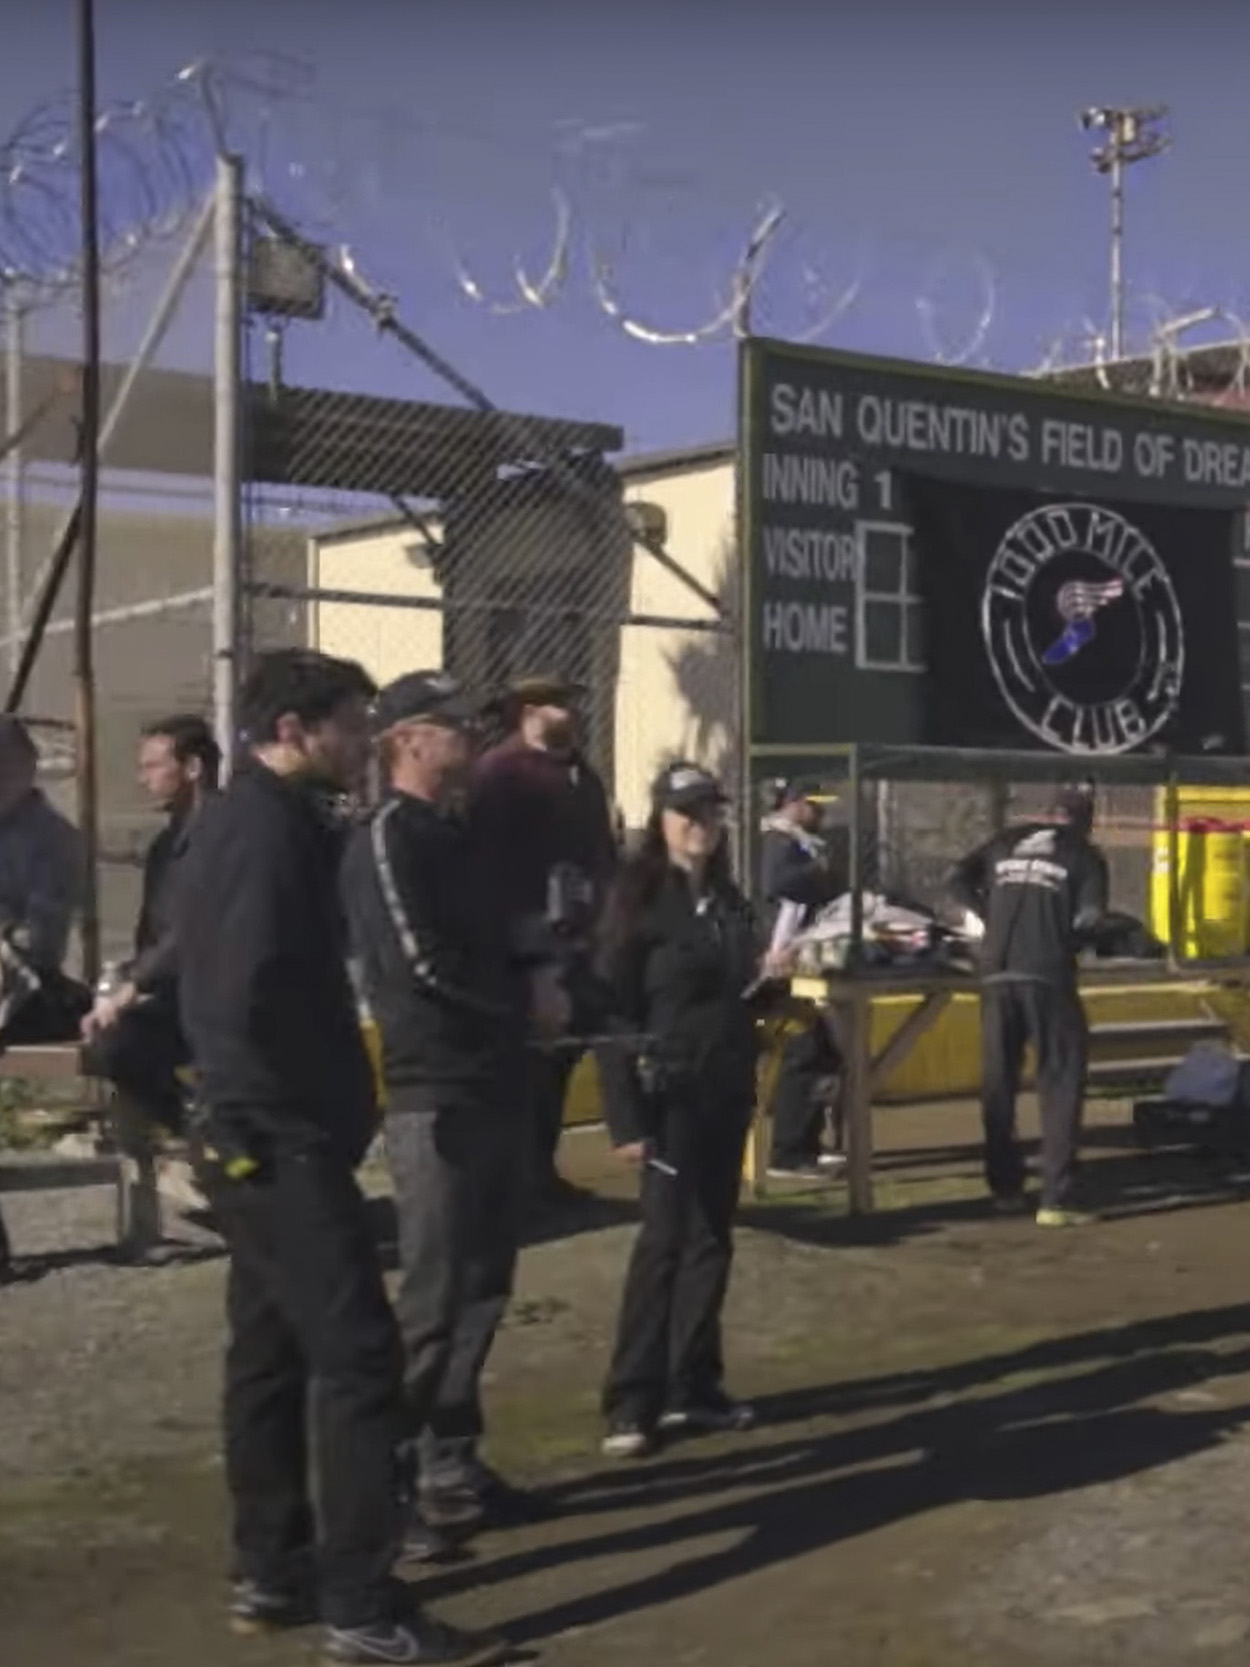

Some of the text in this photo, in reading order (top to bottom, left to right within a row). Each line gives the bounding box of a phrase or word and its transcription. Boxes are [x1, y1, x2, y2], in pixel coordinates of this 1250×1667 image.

[770, 383, 842, 438] SAN
[857, 395, 1029, 461] QUENTIN'S
[1041, 420, 1122, 472] FIELD
[1133, 432, 1174, 478] OF
[763, 453, 892, 509] INNING 1
[763, 525, 858, 581] VISITOR
[763, 602, 849, 654] HOME
[1042, 694, 1149, 751] CLUB
